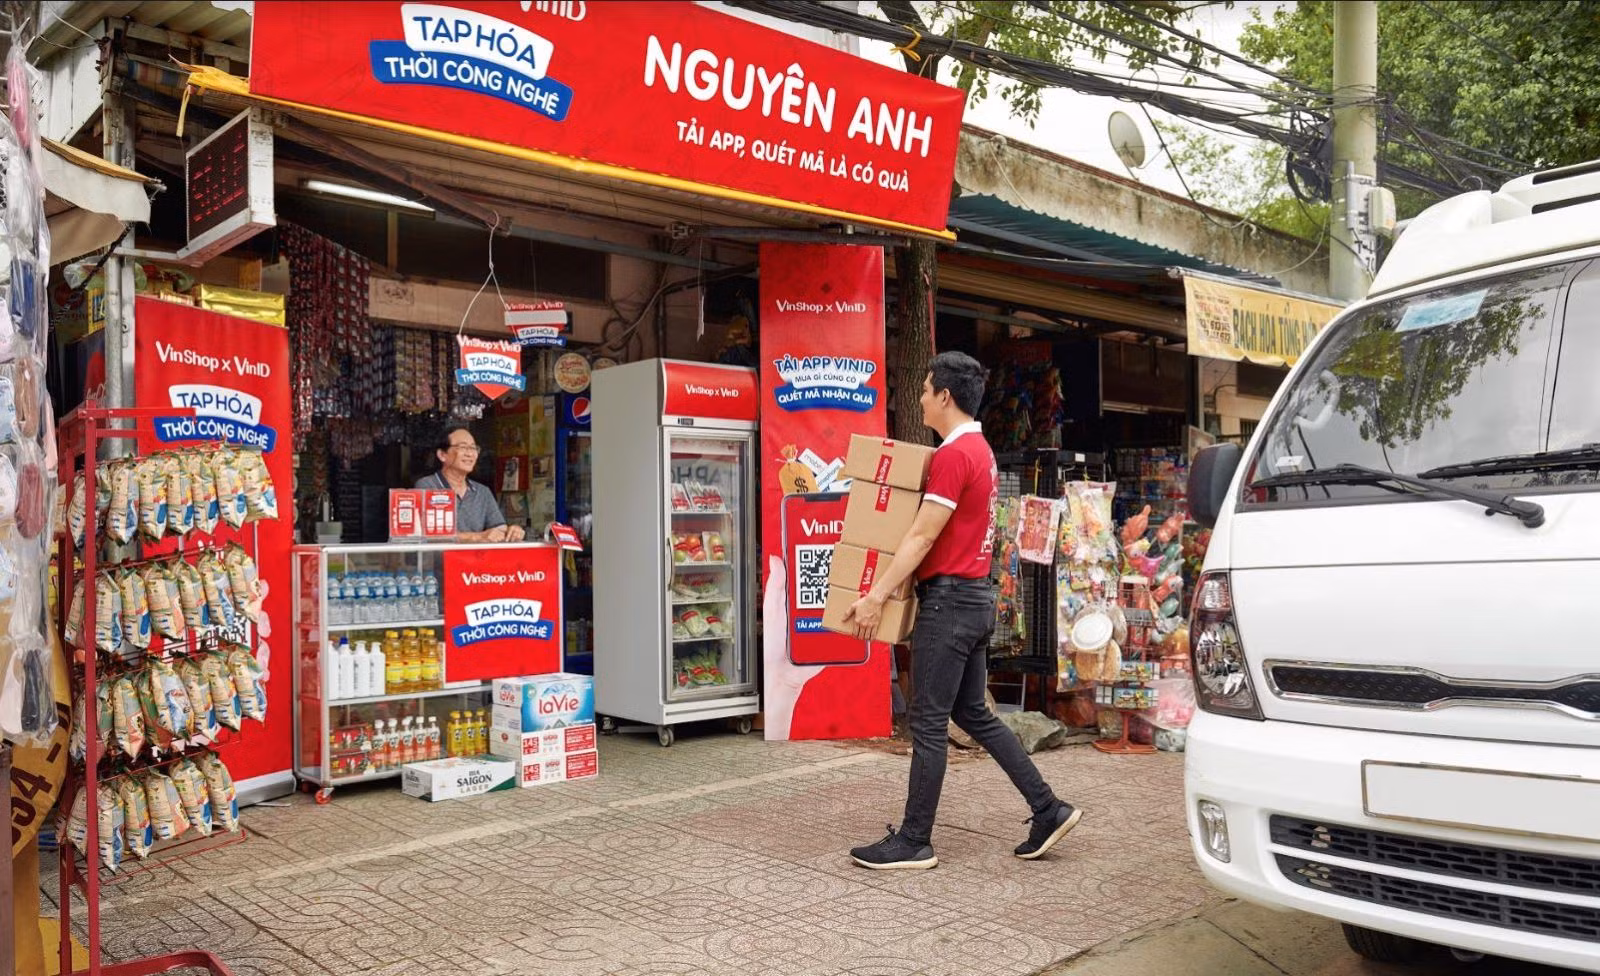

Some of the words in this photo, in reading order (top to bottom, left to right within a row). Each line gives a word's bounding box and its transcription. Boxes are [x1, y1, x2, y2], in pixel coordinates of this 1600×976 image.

[476, 28, 536, 69] HÓA
[384, 52, 438, 78] THỜI
[443, 60, 502, 90] CÔNG
[506, 76, 560, 114] NGHỆ
[644, 35, 836, 132] NGUYÊN
[848, 97, 933, 157] ANH
[677, 118, 704, 145] TẢI
[710, 130, 745, 158] APP,
[751, 140, 796, 165] QUÉT
[800, 150, 824, 173] MÃ
[829, 154, 847, 178] LÀ
[852, 162, 874, 184] CÓ
[878, 169, 909, 192] QUÀ
[776, 299, 823, 314] VinShop
[835, 301, 866, 313] VinID
[456, 334, 492, 351] VinShop
[499, 340, 521, 352] VinID
[156, 341, 219, 372] VinShop
[222, 360, 231, 371] x
[234, 356, 270, 378] VinID
[775, 355, 798, 373] TẢI
[802, 357, 831, 371] APP
[834, 357, 875, 374] VINID
[684, 383, 714, 396] VinShop
[720, 387, 739, 398] VinID
[778, 391, 803, 404] QUÉT
[822, 388, 850, 401] NHẬN
[216, 393, 253, 420] HÓA
[162, 417, 196, 438] THỜI
[198, 419, 235, 438] CÔNG
[801, 518, 844, 537] VinID
[462, 572, 506, 586] VinShop
[517, 570, 545, 583] VinID
[502, 600, 534, 618] HÓA
[459, 626, 486, 643] THỜI
[487, 623, 518, 636] CÔNG
[456, 774, 492, 787] SAIGON
